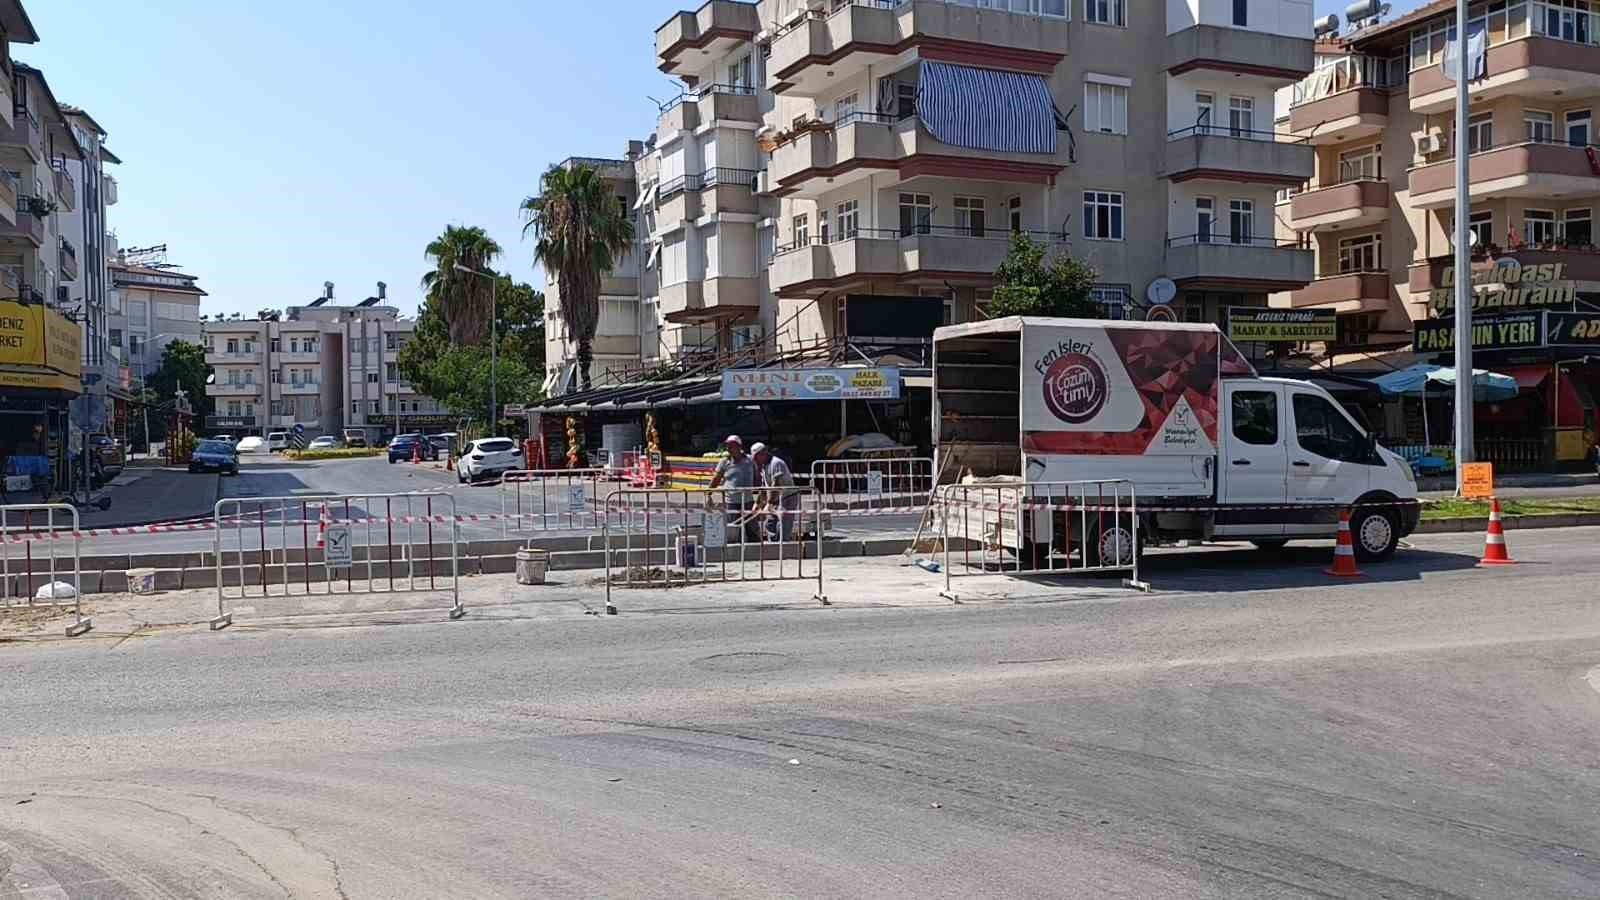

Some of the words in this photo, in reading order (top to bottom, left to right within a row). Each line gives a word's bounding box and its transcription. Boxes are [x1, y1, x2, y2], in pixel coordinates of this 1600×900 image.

[1232, 325, 1267, 336] MANAV
[1270, 325, 1278, 336] &
[1034, 350, 1057, 375] Fen
